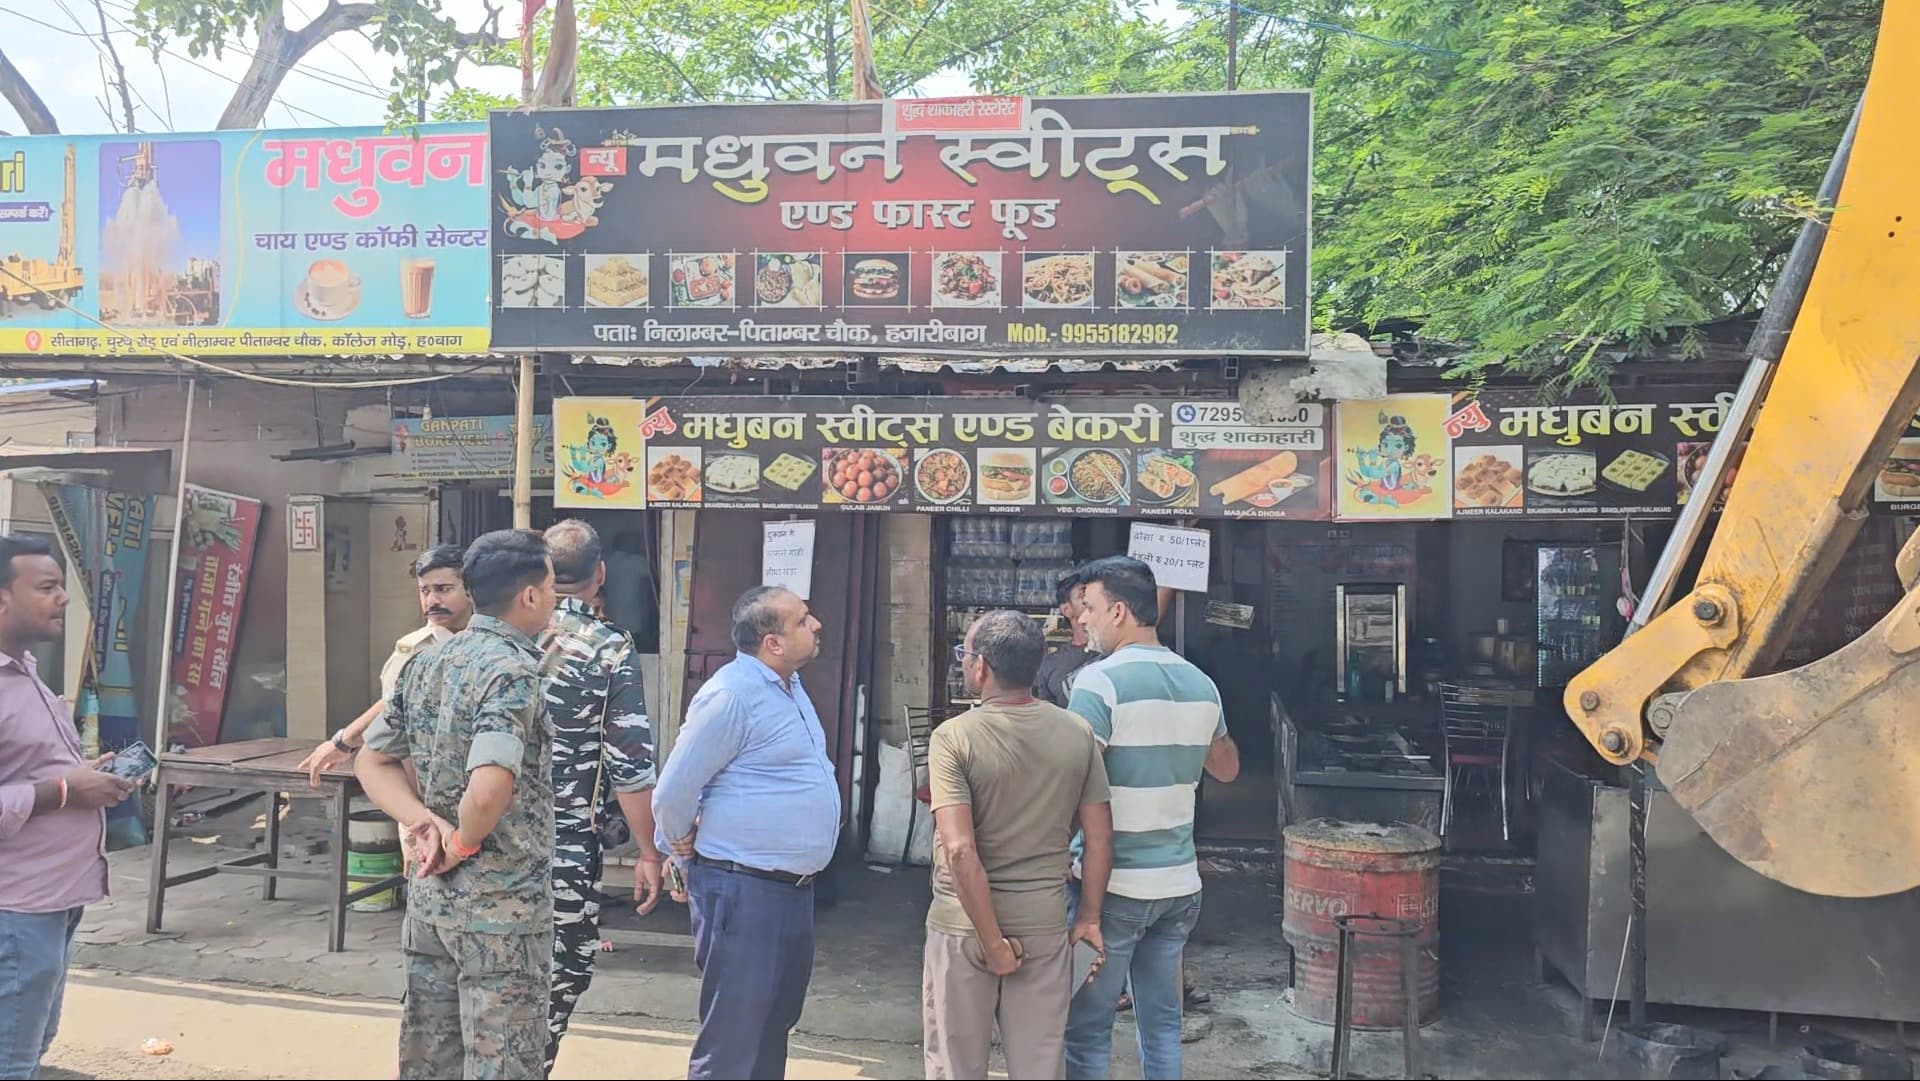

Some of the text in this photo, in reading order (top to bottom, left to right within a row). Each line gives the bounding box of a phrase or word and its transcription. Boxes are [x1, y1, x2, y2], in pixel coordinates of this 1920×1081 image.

[633, 108, 1230, 204] मधुवन स्वीट्स
[780, 199, 1060, 240] एण्ड फास्ट फूड
[255, 224, 488, 250] चाय एण्ड कॉफी सेन्टर
[161, 333, 180, 348] एवं
[332, 333, 376, 348] कॉलेज
[825, 319, 878, 344] चौक,
[884, 318, 987, 343] हजारीबाग
[1062, 322, 1178, 344] 9955182982
[816, 404, 943, 447] स्वीट्स
[952, 413, 1038, 442] एण्ड
[1048, 403, 1164, 443] बेकरी
[1199, 407, 1308, 422] 72950
[1180, 429, 1315, 447] शुद्ध शाकाहारी
[200, 555, 219, 596] ताजा
[191, 635, 206, 660] का
[187, 663, 202, 687] रस
